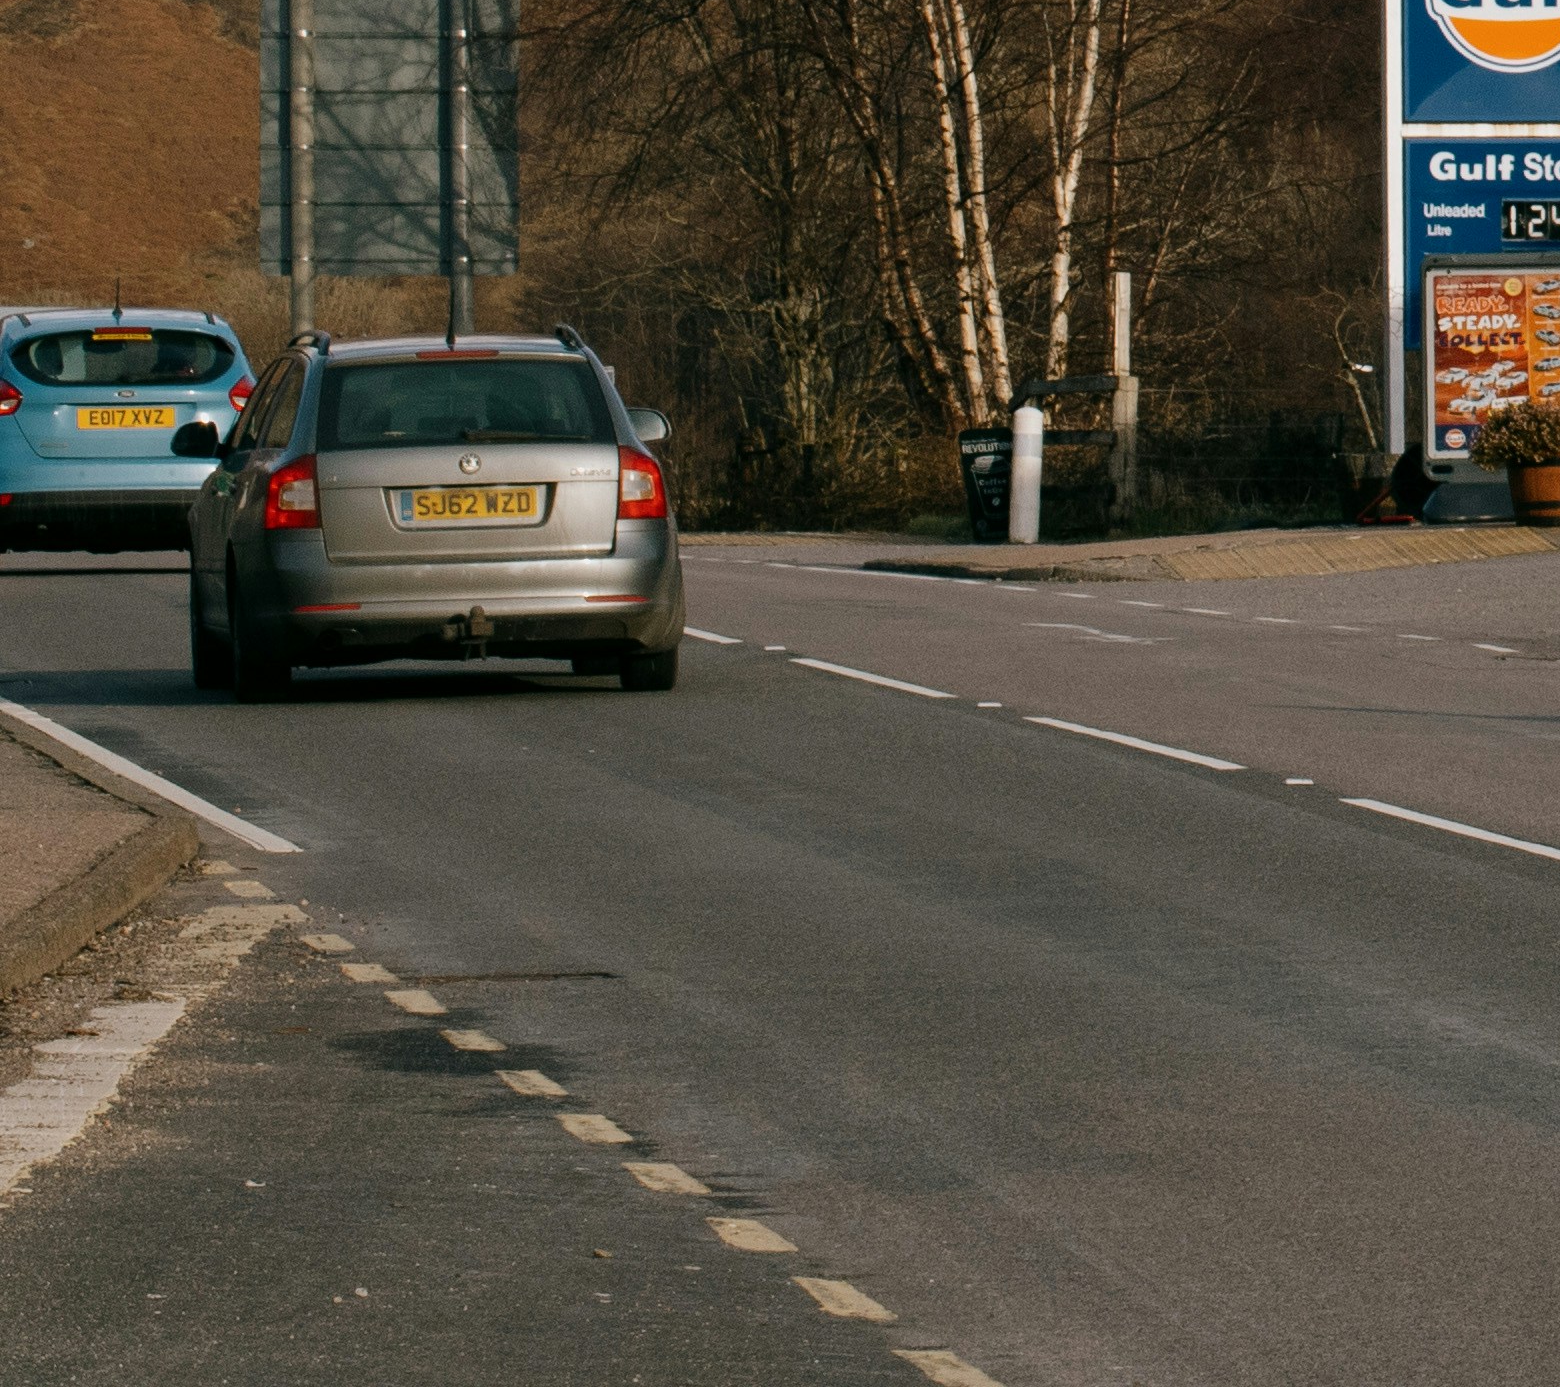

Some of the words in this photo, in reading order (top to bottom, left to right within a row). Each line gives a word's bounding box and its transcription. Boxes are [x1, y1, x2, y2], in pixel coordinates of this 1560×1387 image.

[1429, 151, 1515, 181] Gulf
[1423, 203, 1486, 218] Unleaded
[1427, 224, 1452, 236] Litre
[1436, 295, 1509, 314] READY.
[131, 409, 164, 425] XVZ
[416, 493, 478, 516] SJ62
[485, 491, 531, 513] WZD
